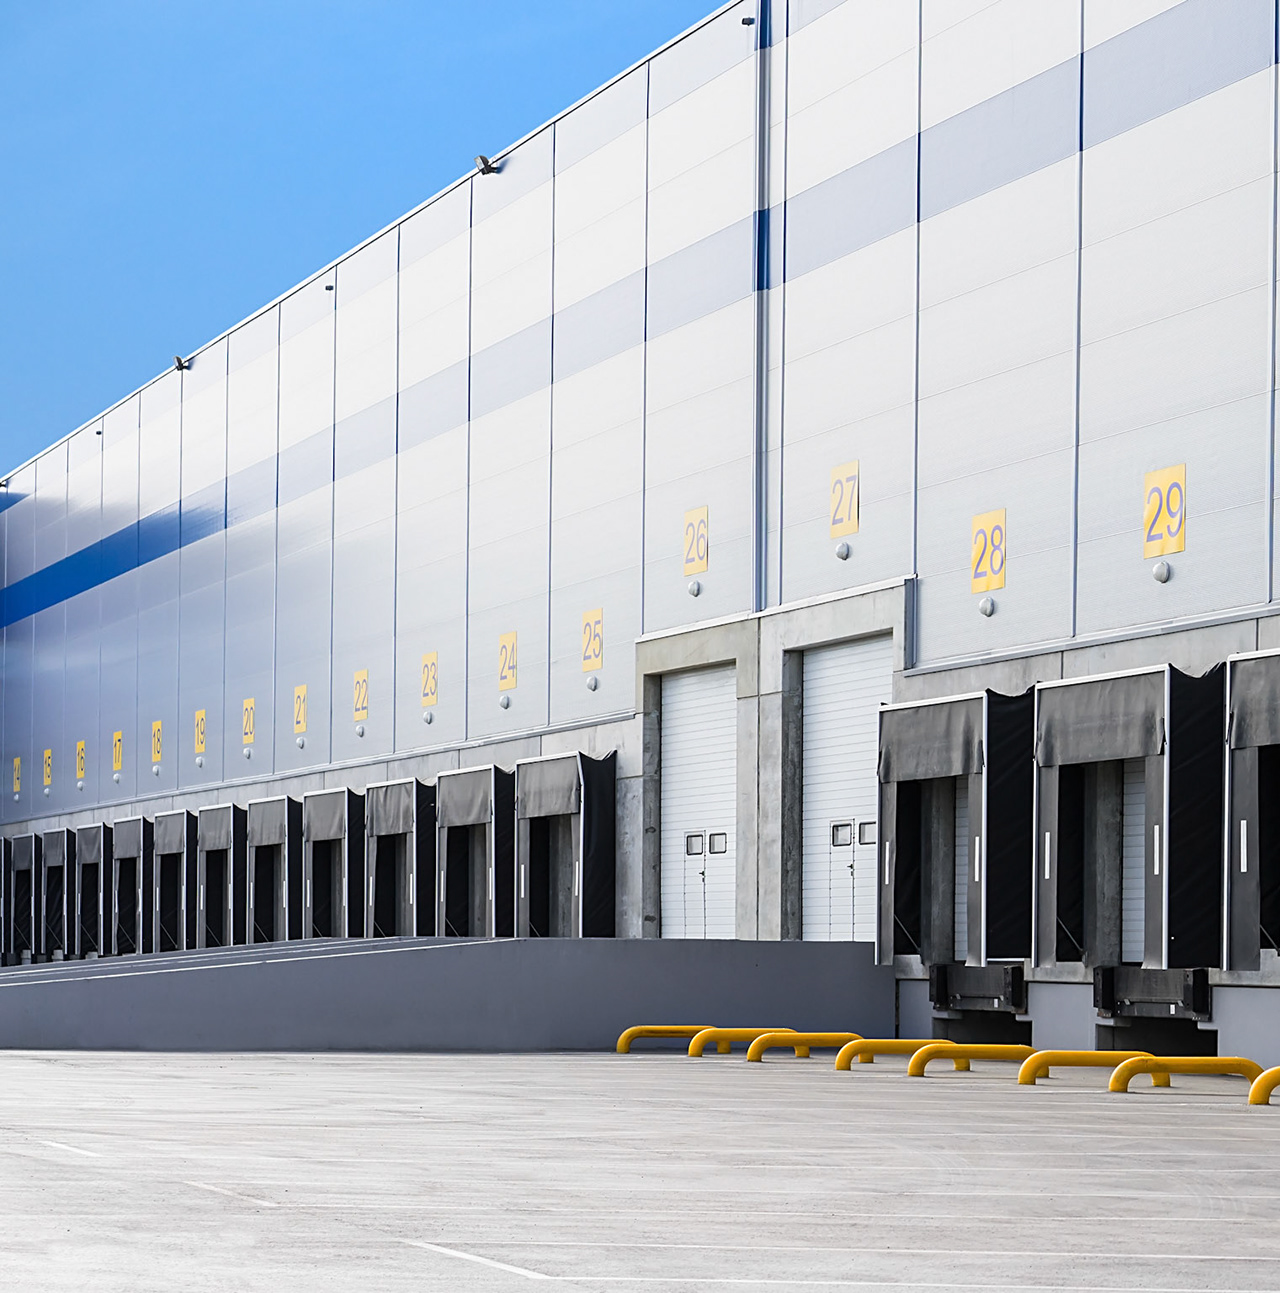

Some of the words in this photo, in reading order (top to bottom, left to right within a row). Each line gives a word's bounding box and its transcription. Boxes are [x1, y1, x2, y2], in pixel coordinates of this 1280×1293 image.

[832, 475, 857, 525] 27
[1147, 482, 1184, 543] 29
[685, 519, 706, 564] 26
[974, 525, 1004, 579] 28
[583, 620, 601, 661] 25
[500, 643, 515, 680] 24
[355, 679, 367, 712] 22
[423, 662, 437, 697] 23
[244, 706, 253, 735] 20
[296, 694, 305, 724] 21
[153, 728, 160, 754] 18
[196, 717, 204, 745] 19
[77, 748, 84, 772] 16
[114, 738, 121, 763] 17
[44, 756, 51, 779] 15
